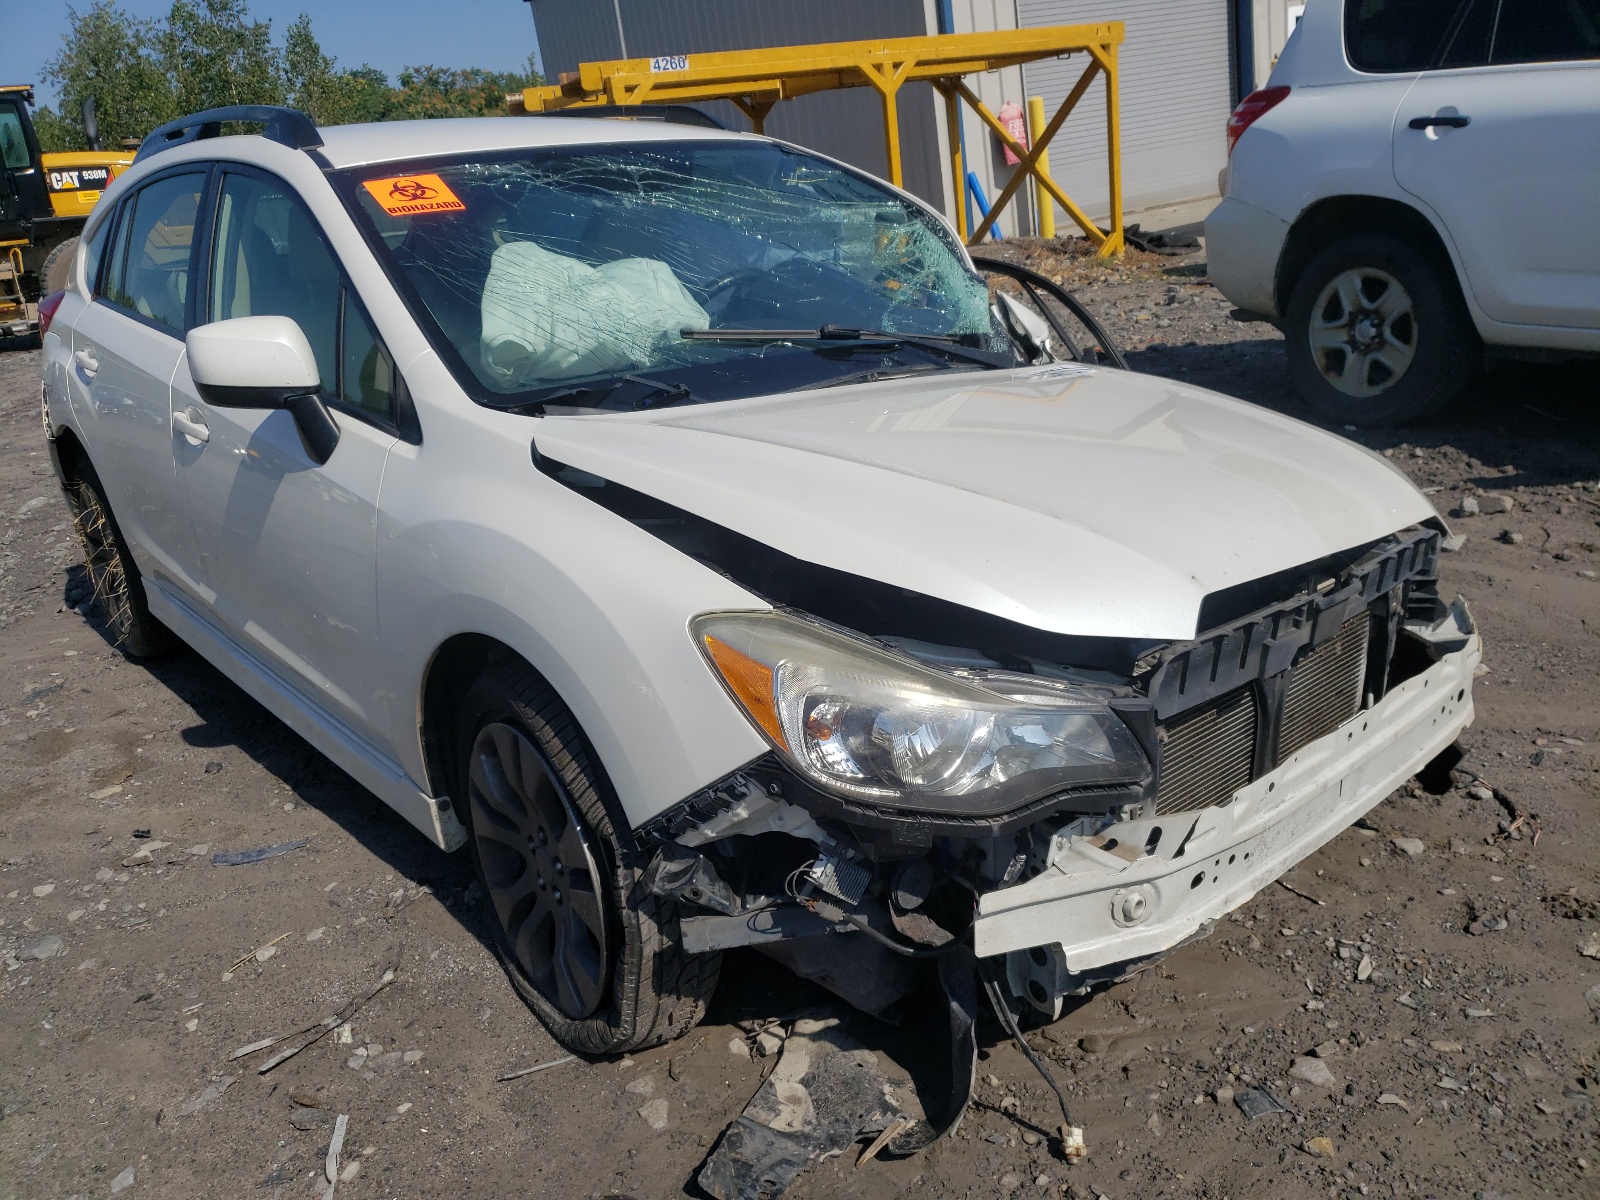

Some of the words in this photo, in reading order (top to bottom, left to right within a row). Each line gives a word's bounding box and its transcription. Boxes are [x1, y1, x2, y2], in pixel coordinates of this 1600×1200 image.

[653, 56, 686, 71] 4260
[50, 171, 80, 190] CAT
[82, 169, 107, 180] 938M
[387, 201, 462, 214] BIOHAZARD
